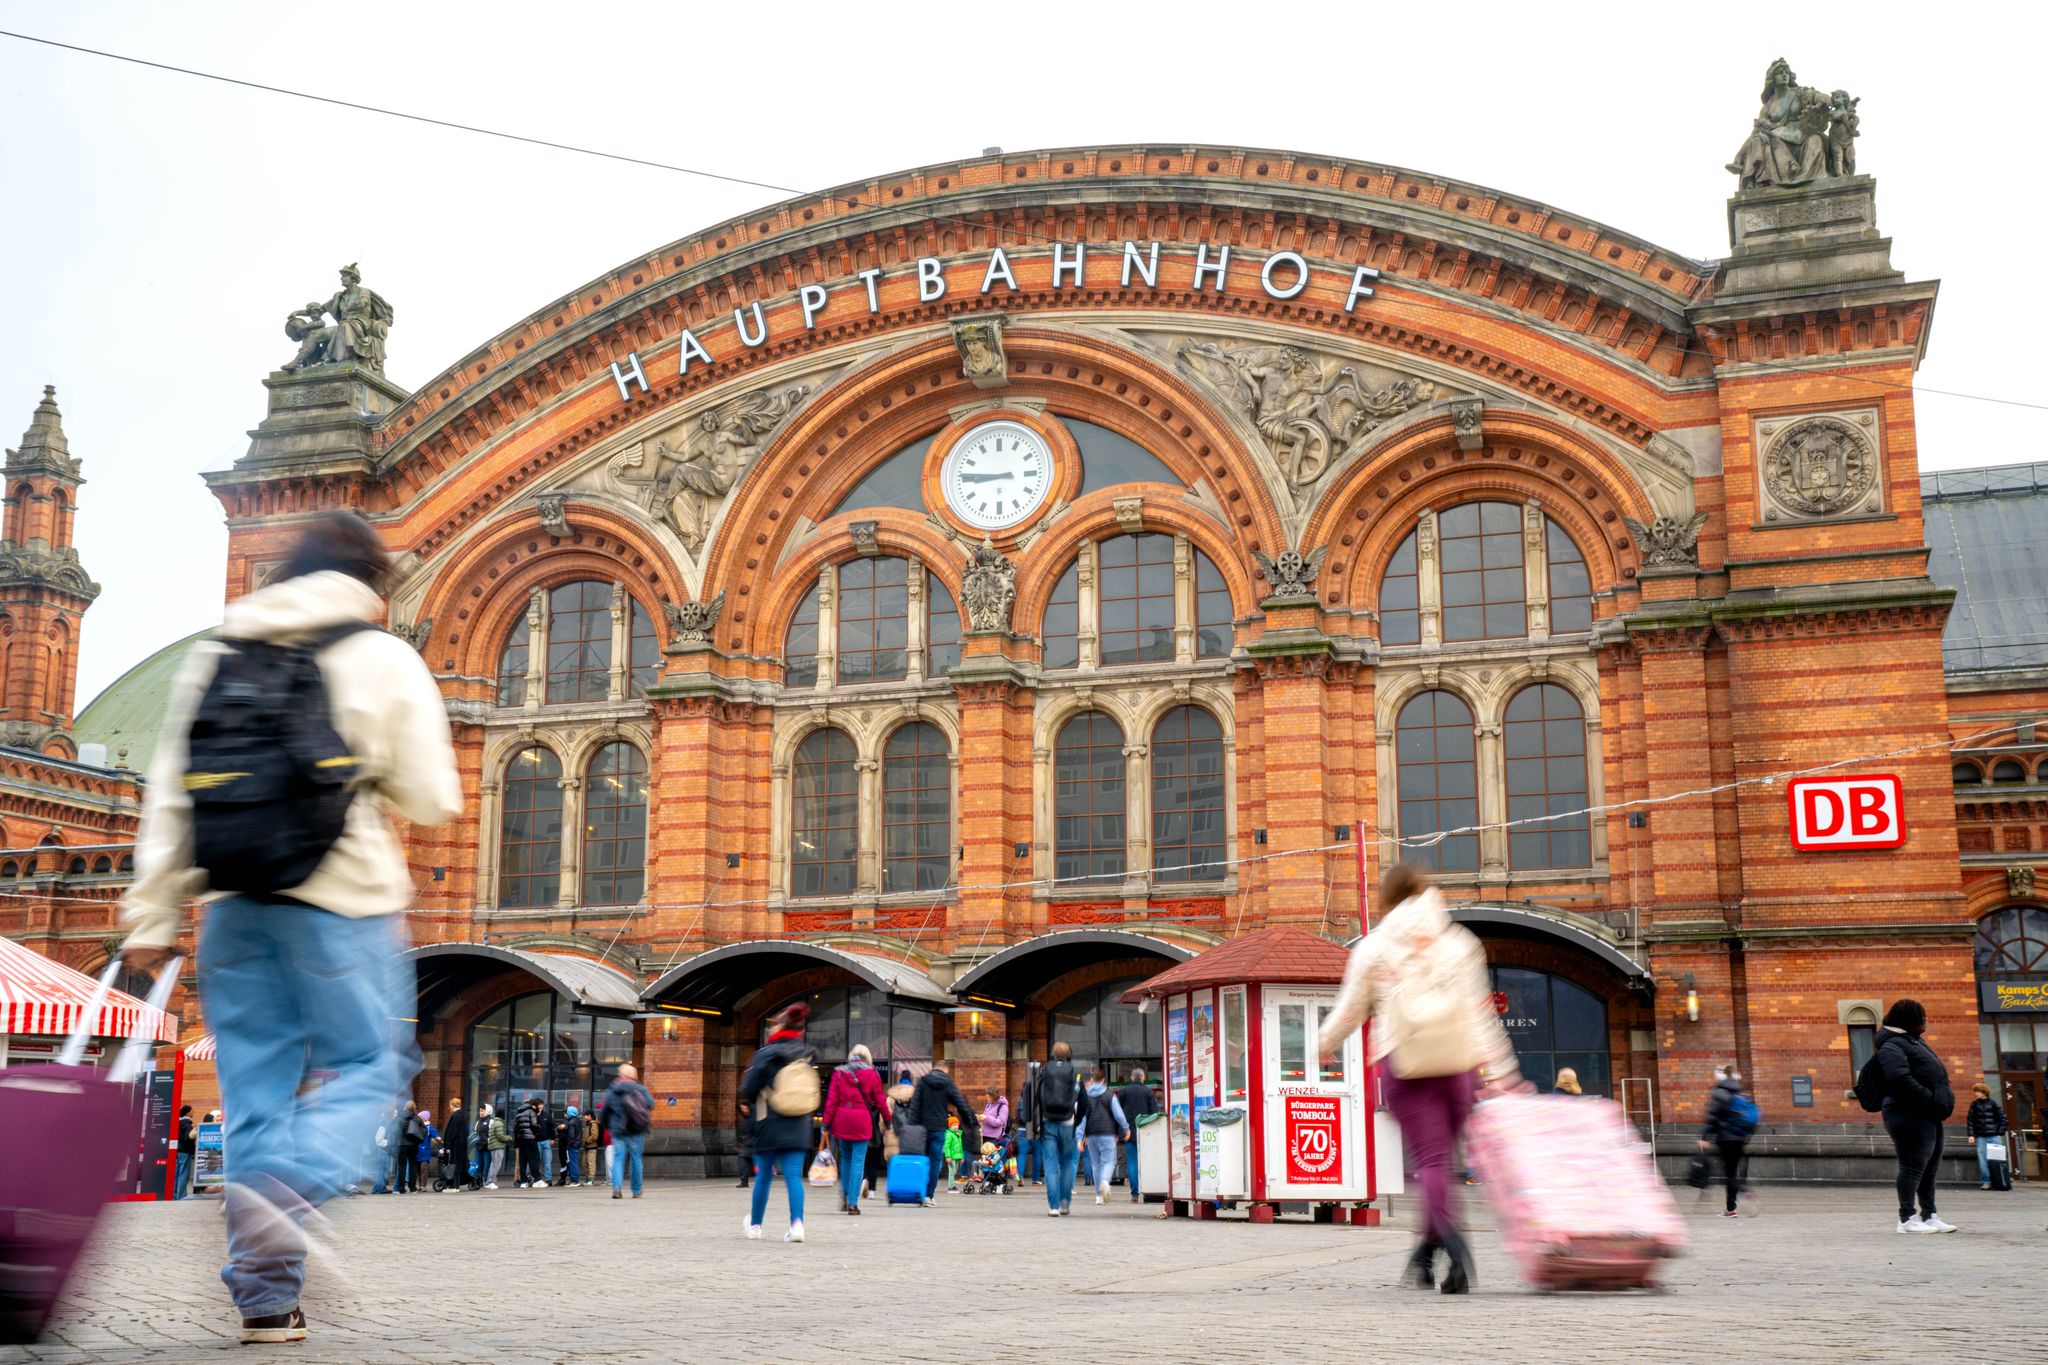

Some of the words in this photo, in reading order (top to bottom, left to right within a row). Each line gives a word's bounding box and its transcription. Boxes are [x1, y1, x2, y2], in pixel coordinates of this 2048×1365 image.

[609, 241, 1381, 401] HAUPTBAHNHOF
[1803, 787, 1890, 837] DB
[1997, 984, 2040, 996] Kamps
[1290, 1101, 1336, 1109] BÜRGERPARK-
[1290, 1111, 1336, 1120] TOMBOLA
[1202, 1131, 1217, 1142] LOS
[1300, 1129, 1328, 1152] 70
[1303, 1152, 1325, 1160] JAHRE
